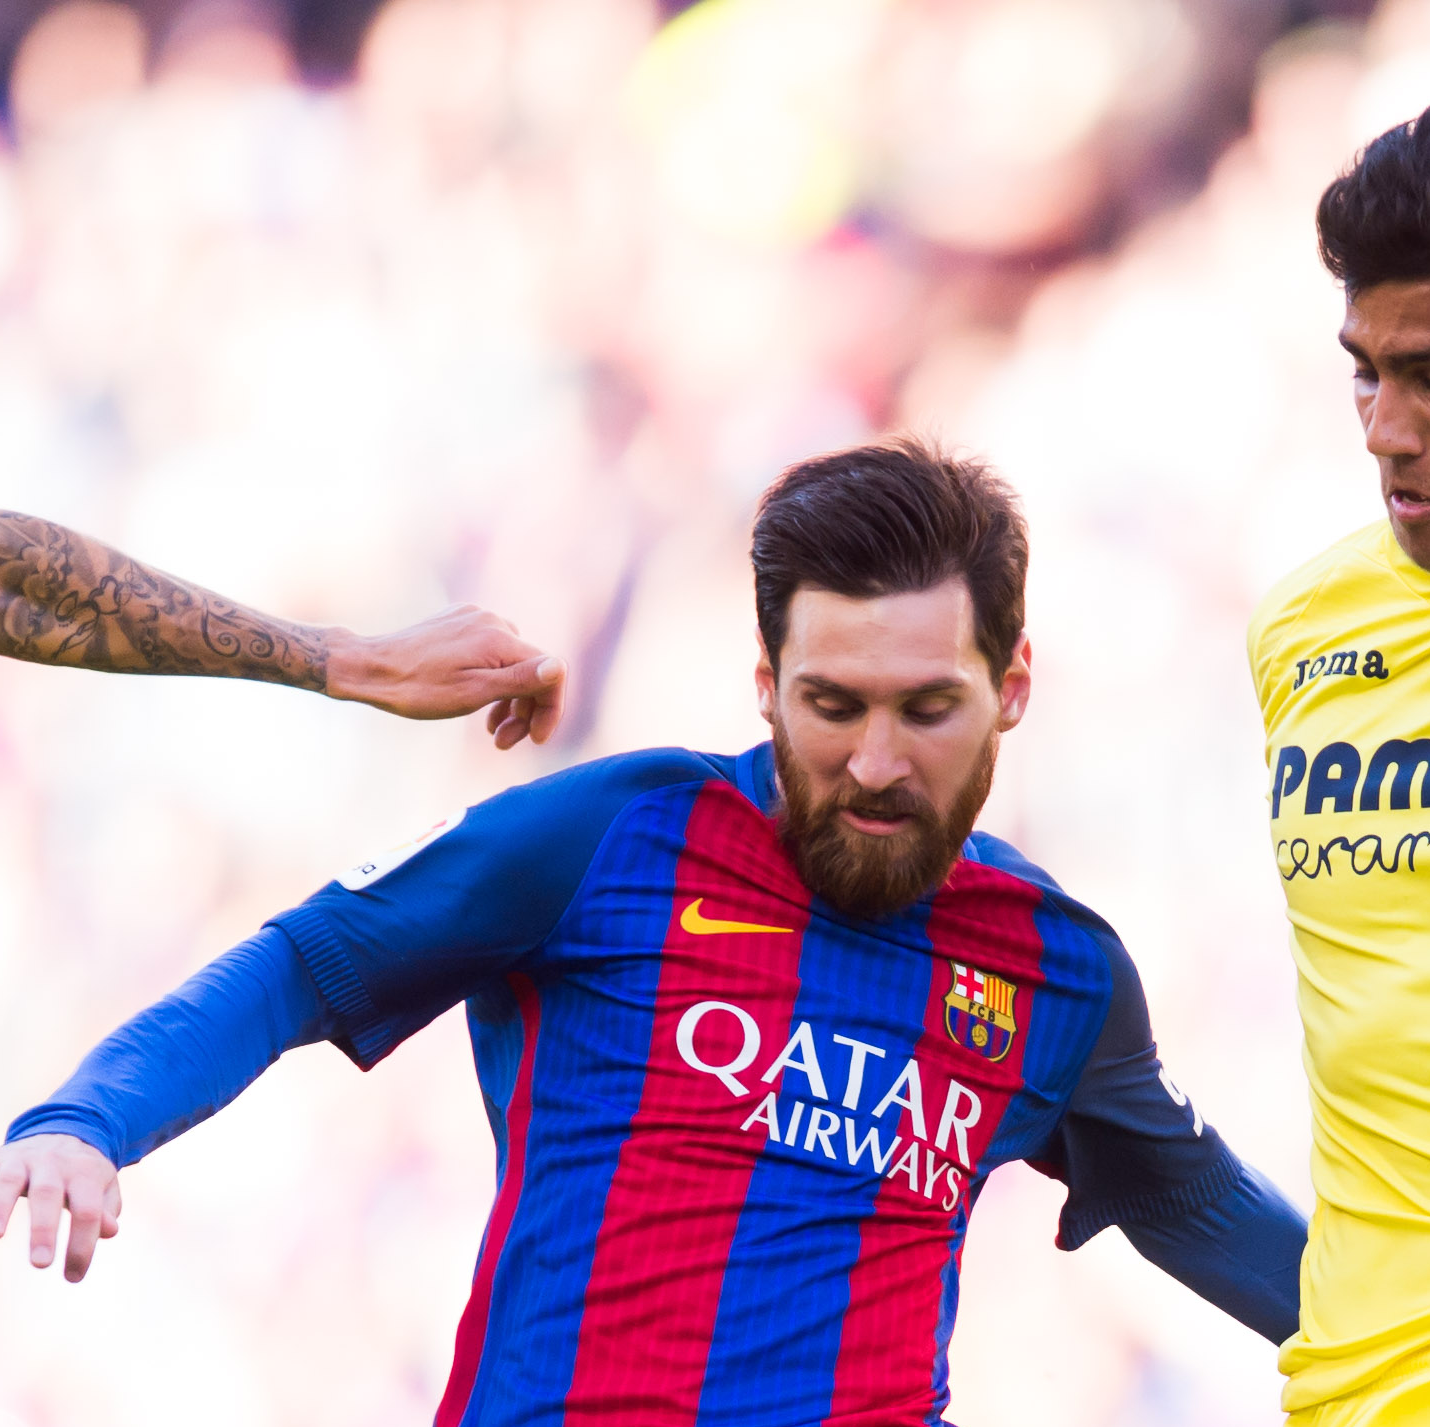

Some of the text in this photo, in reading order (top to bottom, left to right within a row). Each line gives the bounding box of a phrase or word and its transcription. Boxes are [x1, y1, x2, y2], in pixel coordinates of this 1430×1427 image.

[1293, 650, 1389, 691] Joma
[677, 1002, 982, 1170] QATAR
[741, 1092, 963, 1211] AIRWAYS
